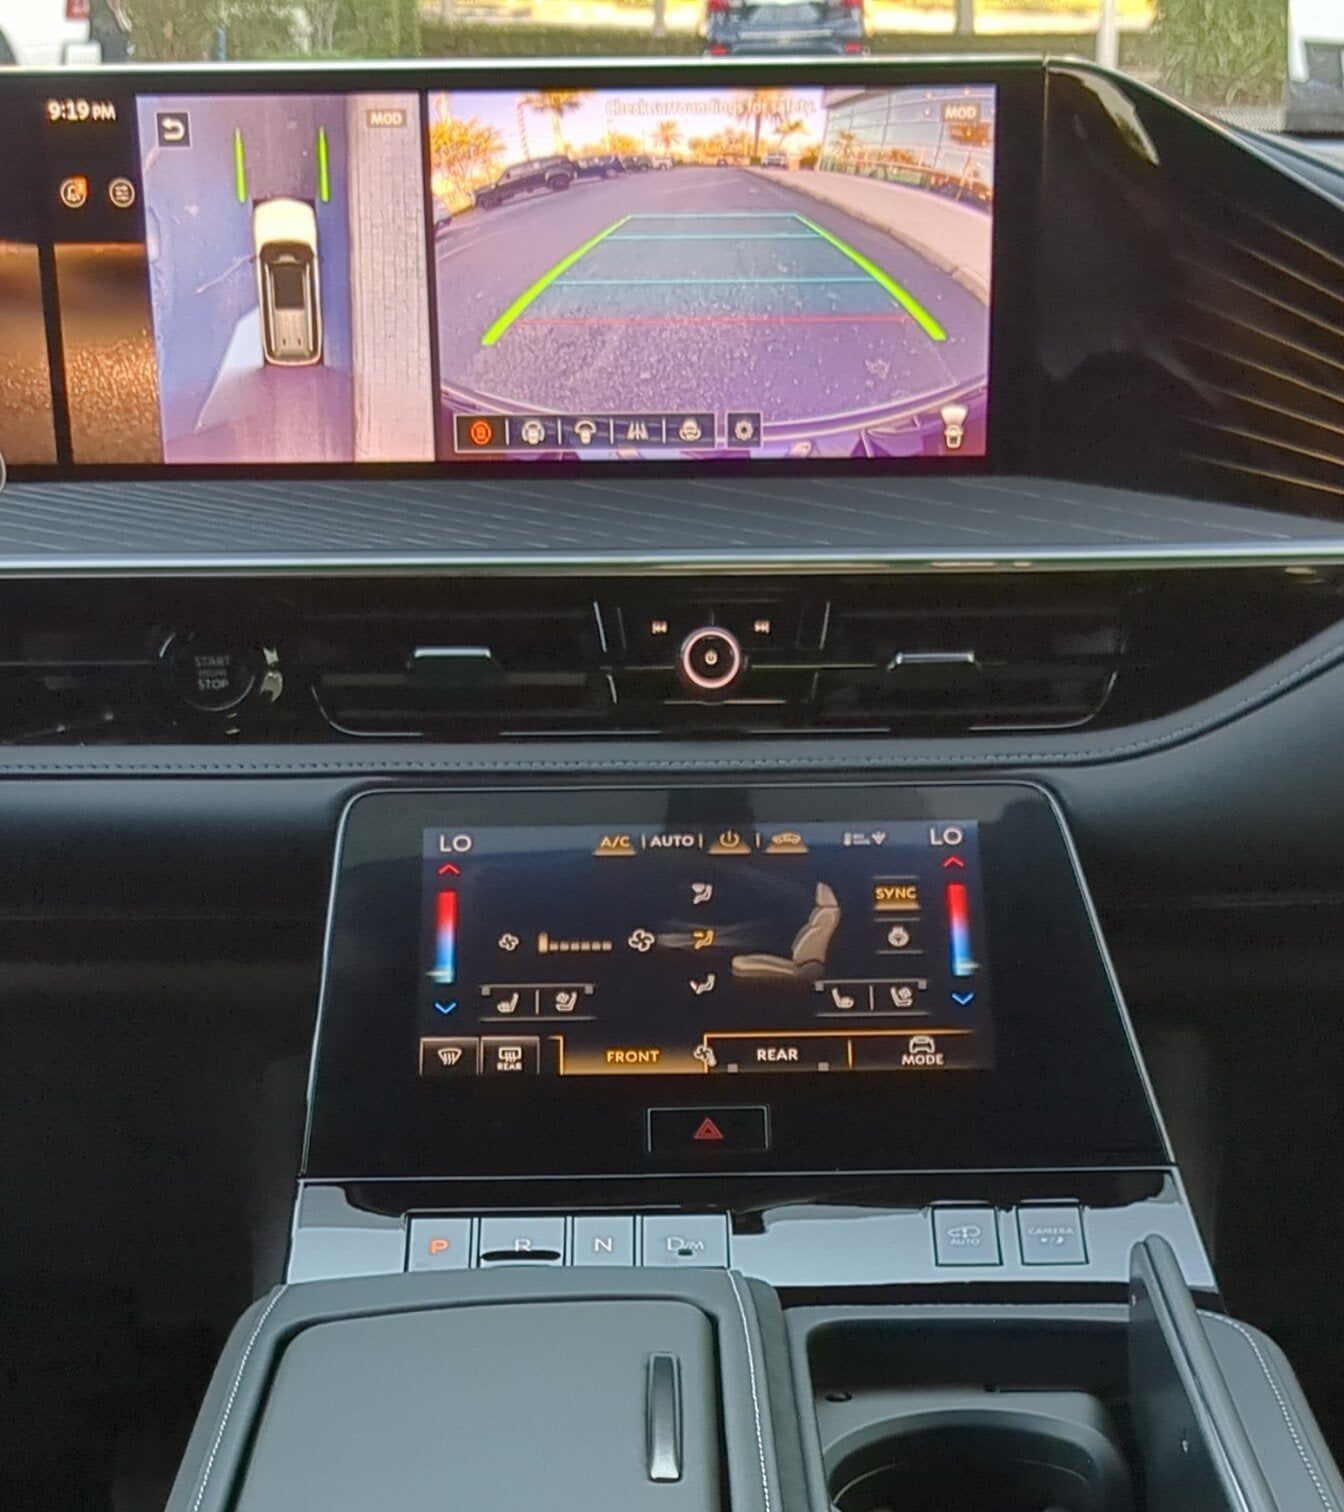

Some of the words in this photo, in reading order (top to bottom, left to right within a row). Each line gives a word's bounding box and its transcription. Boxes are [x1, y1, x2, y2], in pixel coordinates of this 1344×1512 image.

[47, 100, 90, 121] 9:19
[92, 102, 117, 121] PM
[944, 105, 979, 121] MOD
[370, 112, 403, 126] MOD
[198, 679, 230, 690] STOP
[440, 834, 473, 853] LO
[600, 835, 631, 848] A/C
[650, 834, 696, 848] AUTO
[930, 828, 964, 846] LO
[875, 886, 918, 900] SYNC
[606, 1050, 660, 1064] FRONT
[757, 1048, 799, 1062] REAR
[901, 1053, 944, 1067] MODE
[497, 1062, 523, 1072] REAR
[428, 1239, 449, 1255] P
[514, 1238, 532, 1252] R
[594, 1237, 613, 1252] N
